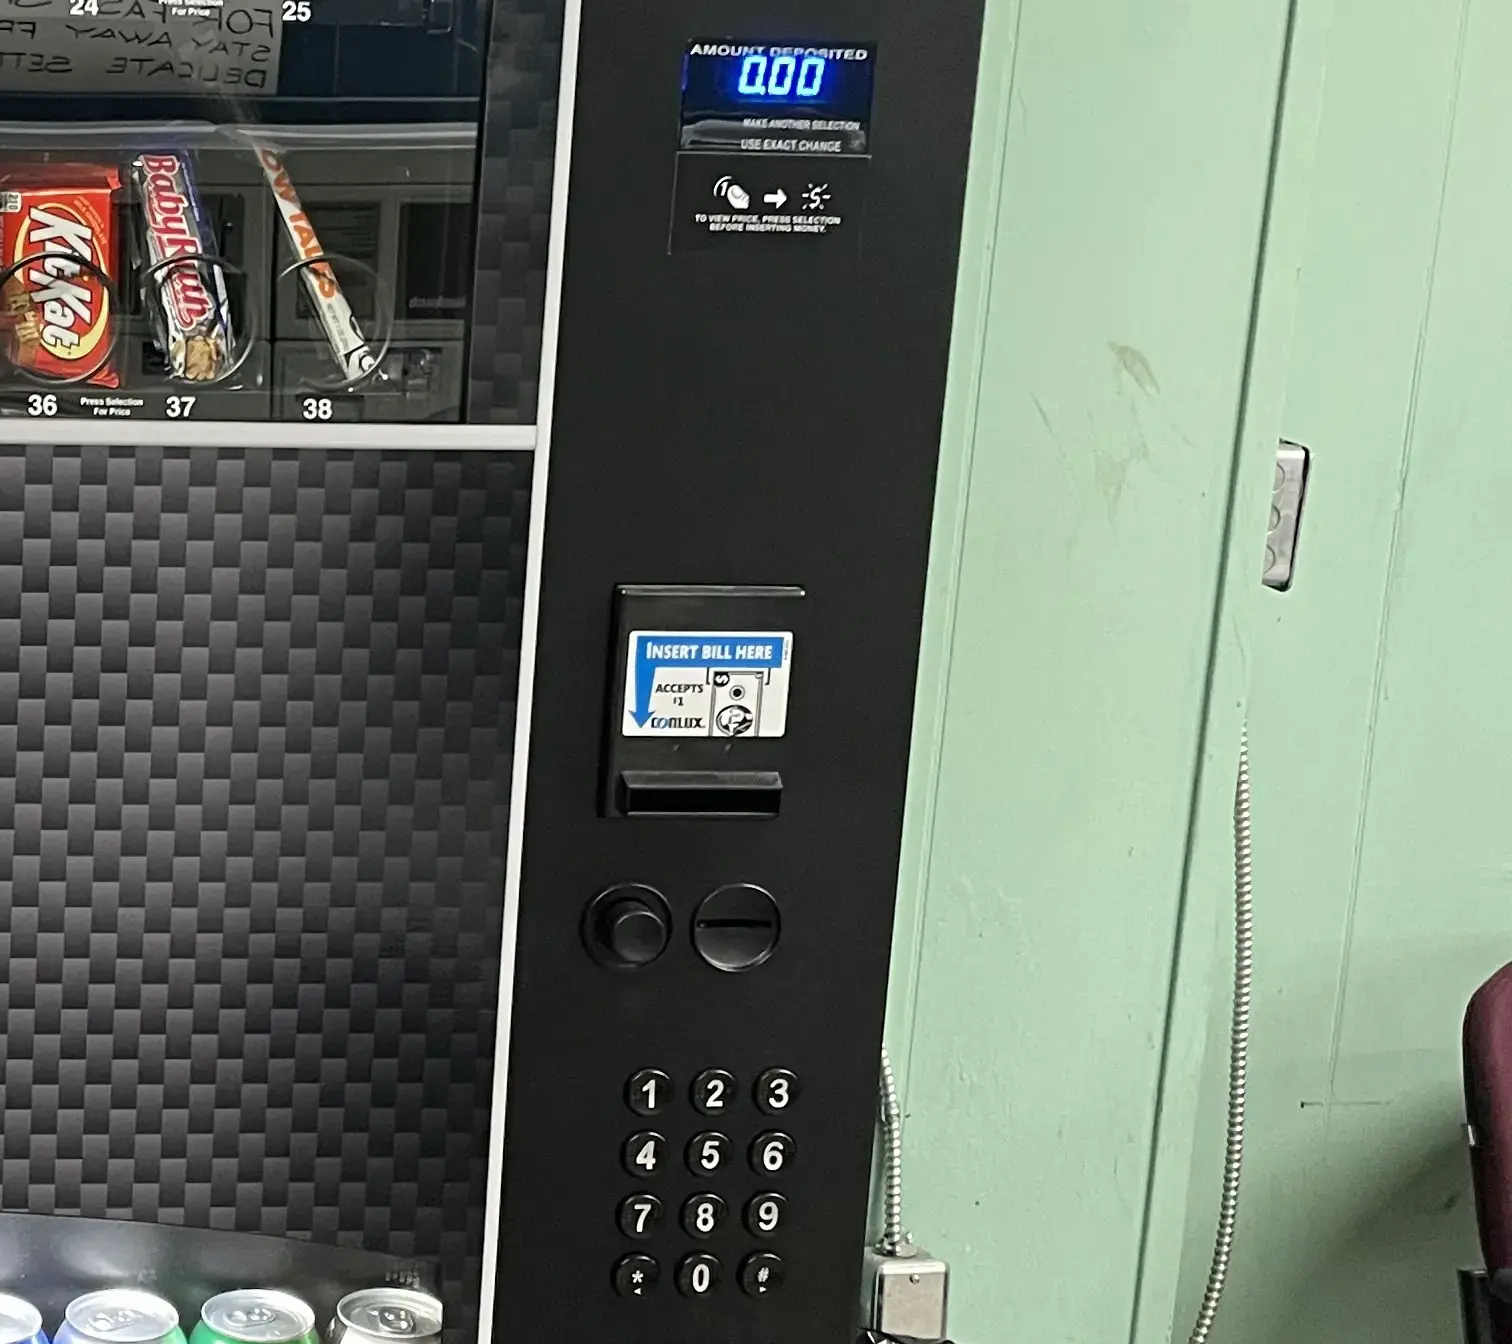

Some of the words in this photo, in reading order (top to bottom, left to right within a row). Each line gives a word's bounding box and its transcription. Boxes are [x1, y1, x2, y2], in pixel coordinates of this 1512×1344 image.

[282, 0, 312, 23] 25
[690, 44, 766, 56] AMOUNT
[769, 46, 869, 61] DEPOSITED
[812, 120, 862, 131] SELECTION
[740, 138, 763, 150] USE
[763, 139, 798, 151] EXACT
[798, 140, 843, 153] CHANGE
[695, 214, 708, 223] TO
[27, 394, 59, 417] 36
[166, 395, 197, 418] 37
[302, 398, 334, 421] 38
[645, 641, 700, 660] INSERT
[701, 644, 732, 660] BILL
[735, 645, 773, 660] HERE
[655, 683, 705, 694] ACCEPTS
[650, 716, 704, 730] CONLUX
[642, 1079, 657, 1109] 1
[705, 1079, 725, 1109] 2
[768, 1078, 790, 1109] 3
[635, 1140, 657, 1171] 4
[701, 1140, 720, 1170] 5
[763, 1140, 785, 1171] 6
[633, 1204, 652, 1233] 7
[696, 1202, 714, 1233] 8
[758, 1201, 779, 1232] 9
[692, 1264, 710, 1292] 0
